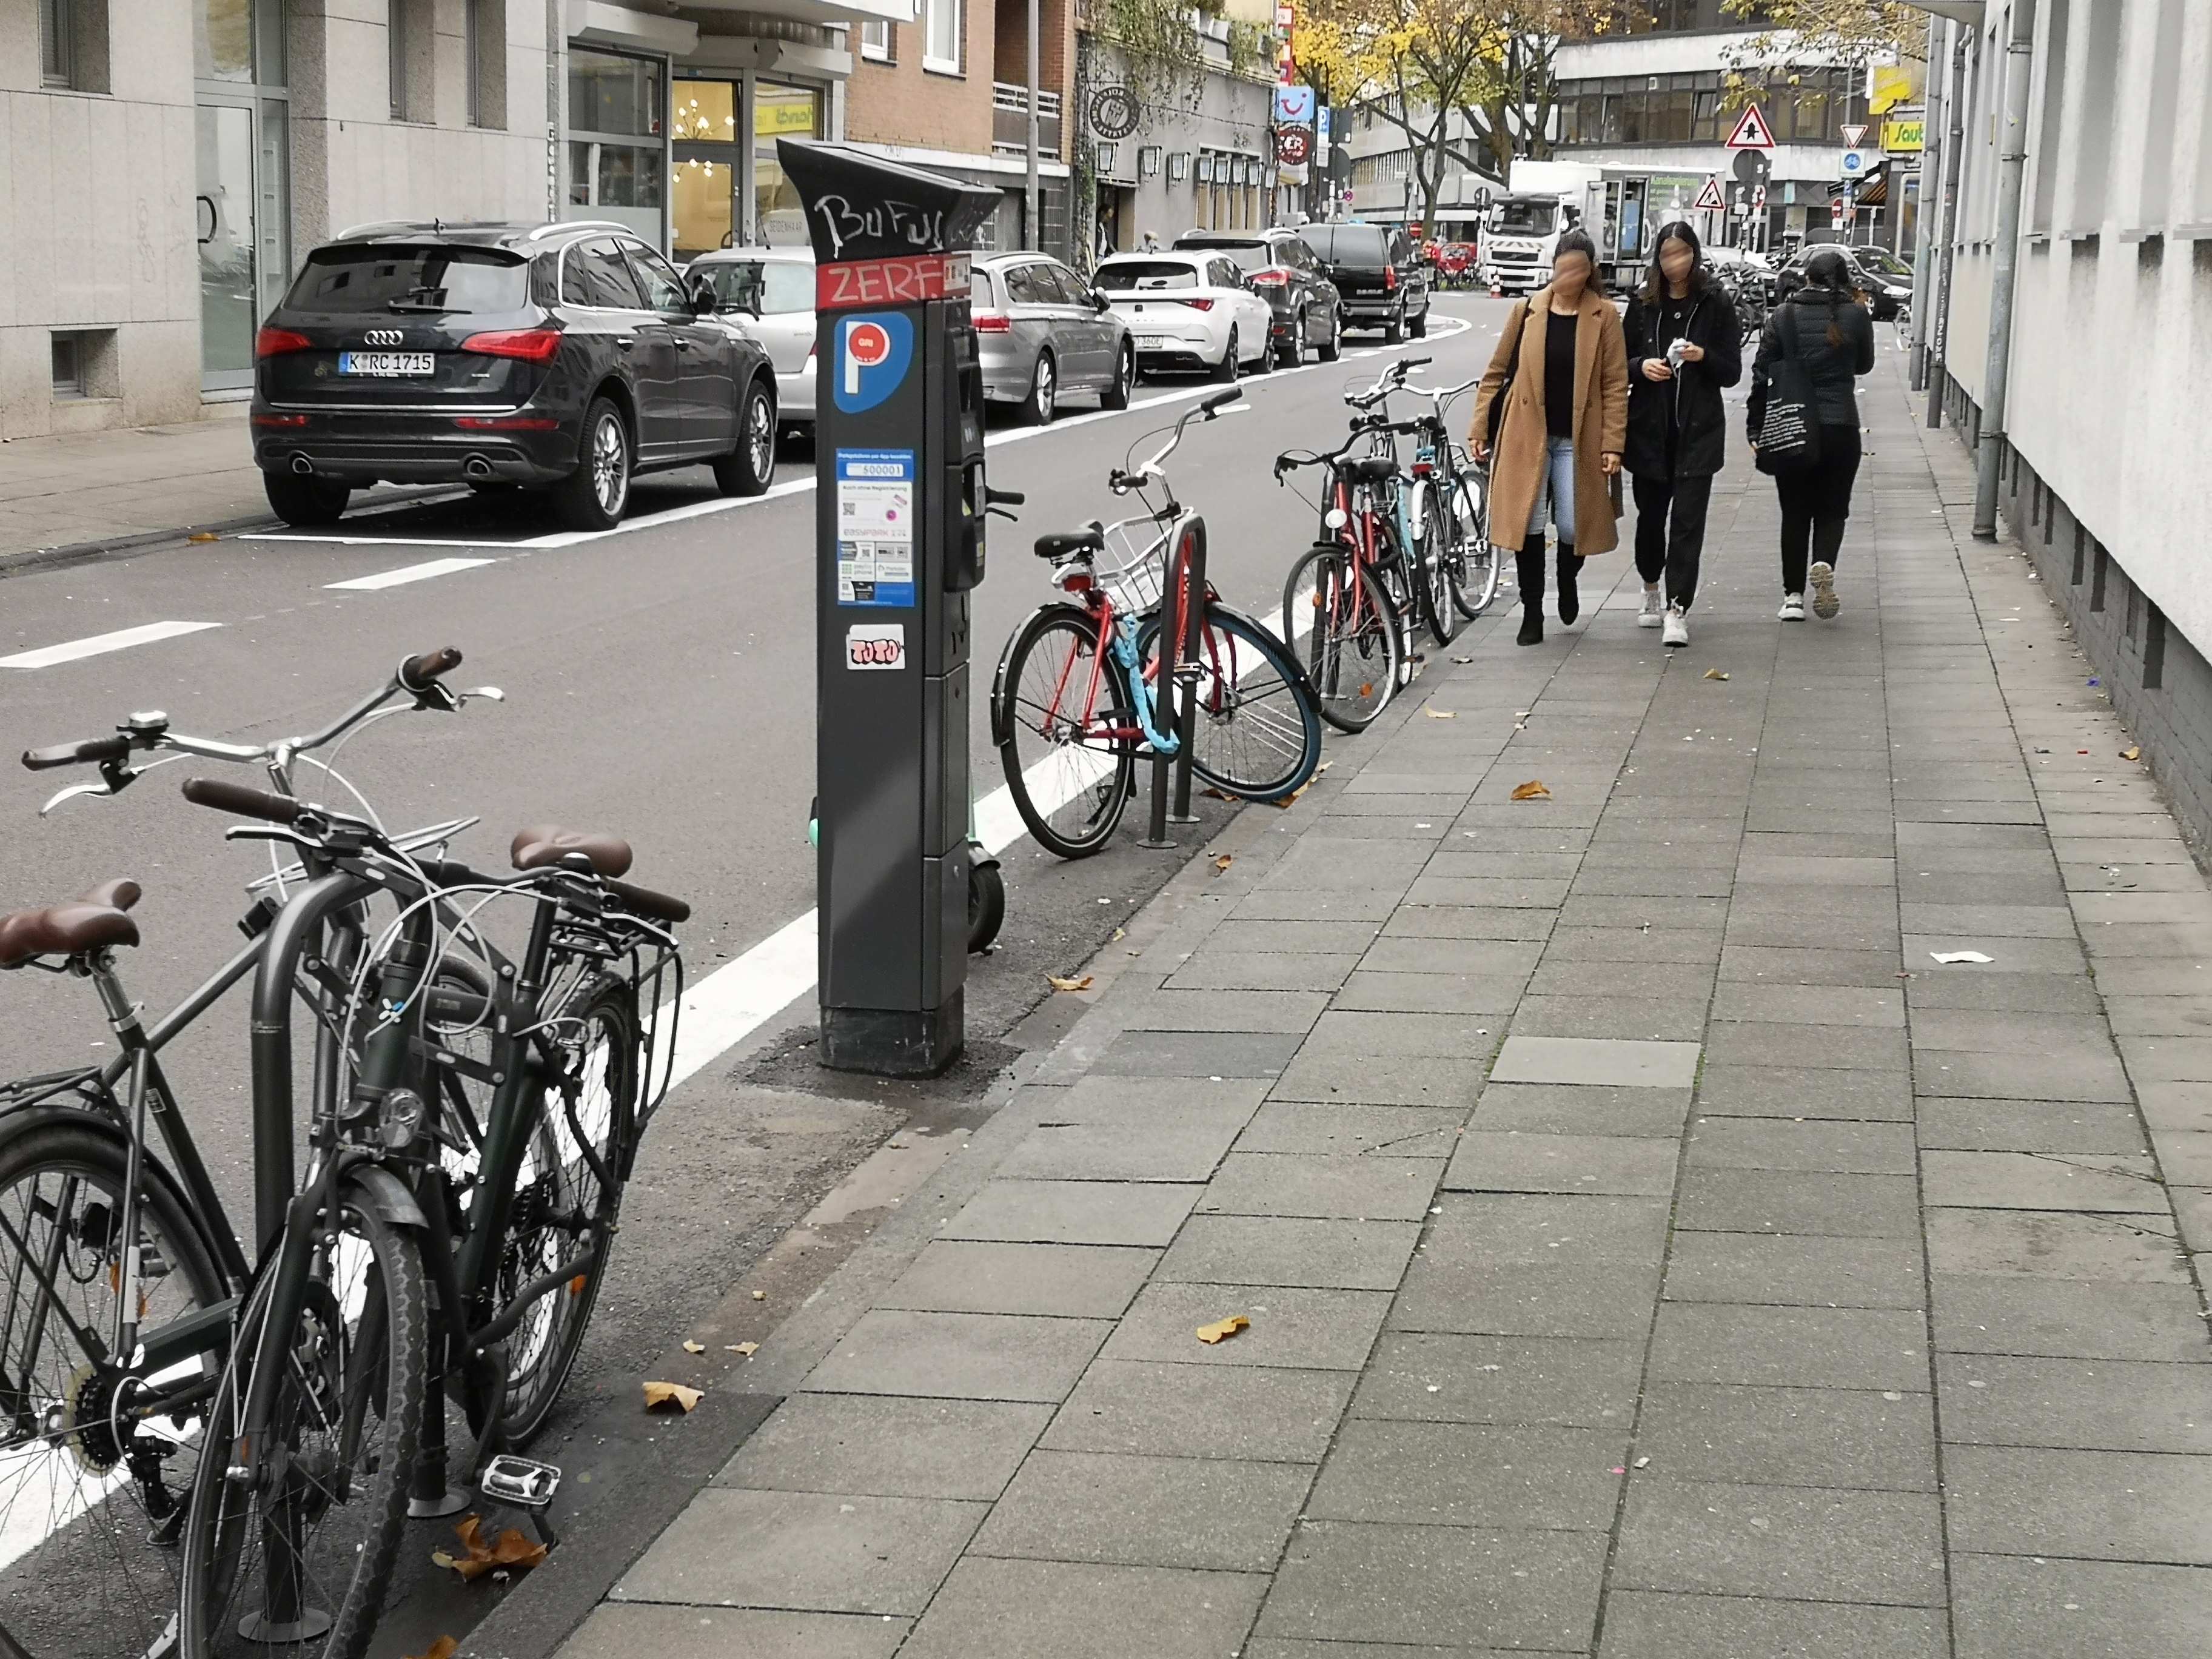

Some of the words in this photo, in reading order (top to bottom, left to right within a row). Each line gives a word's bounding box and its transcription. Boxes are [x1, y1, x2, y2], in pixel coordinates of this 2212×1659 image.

[349, 354, 359, 369] K
[369, 354, 389, 369] RC
[393, 355, 431, 370] 1715
[845, 320, 890, 394] P
[863, 465, 900, 475] 500001
